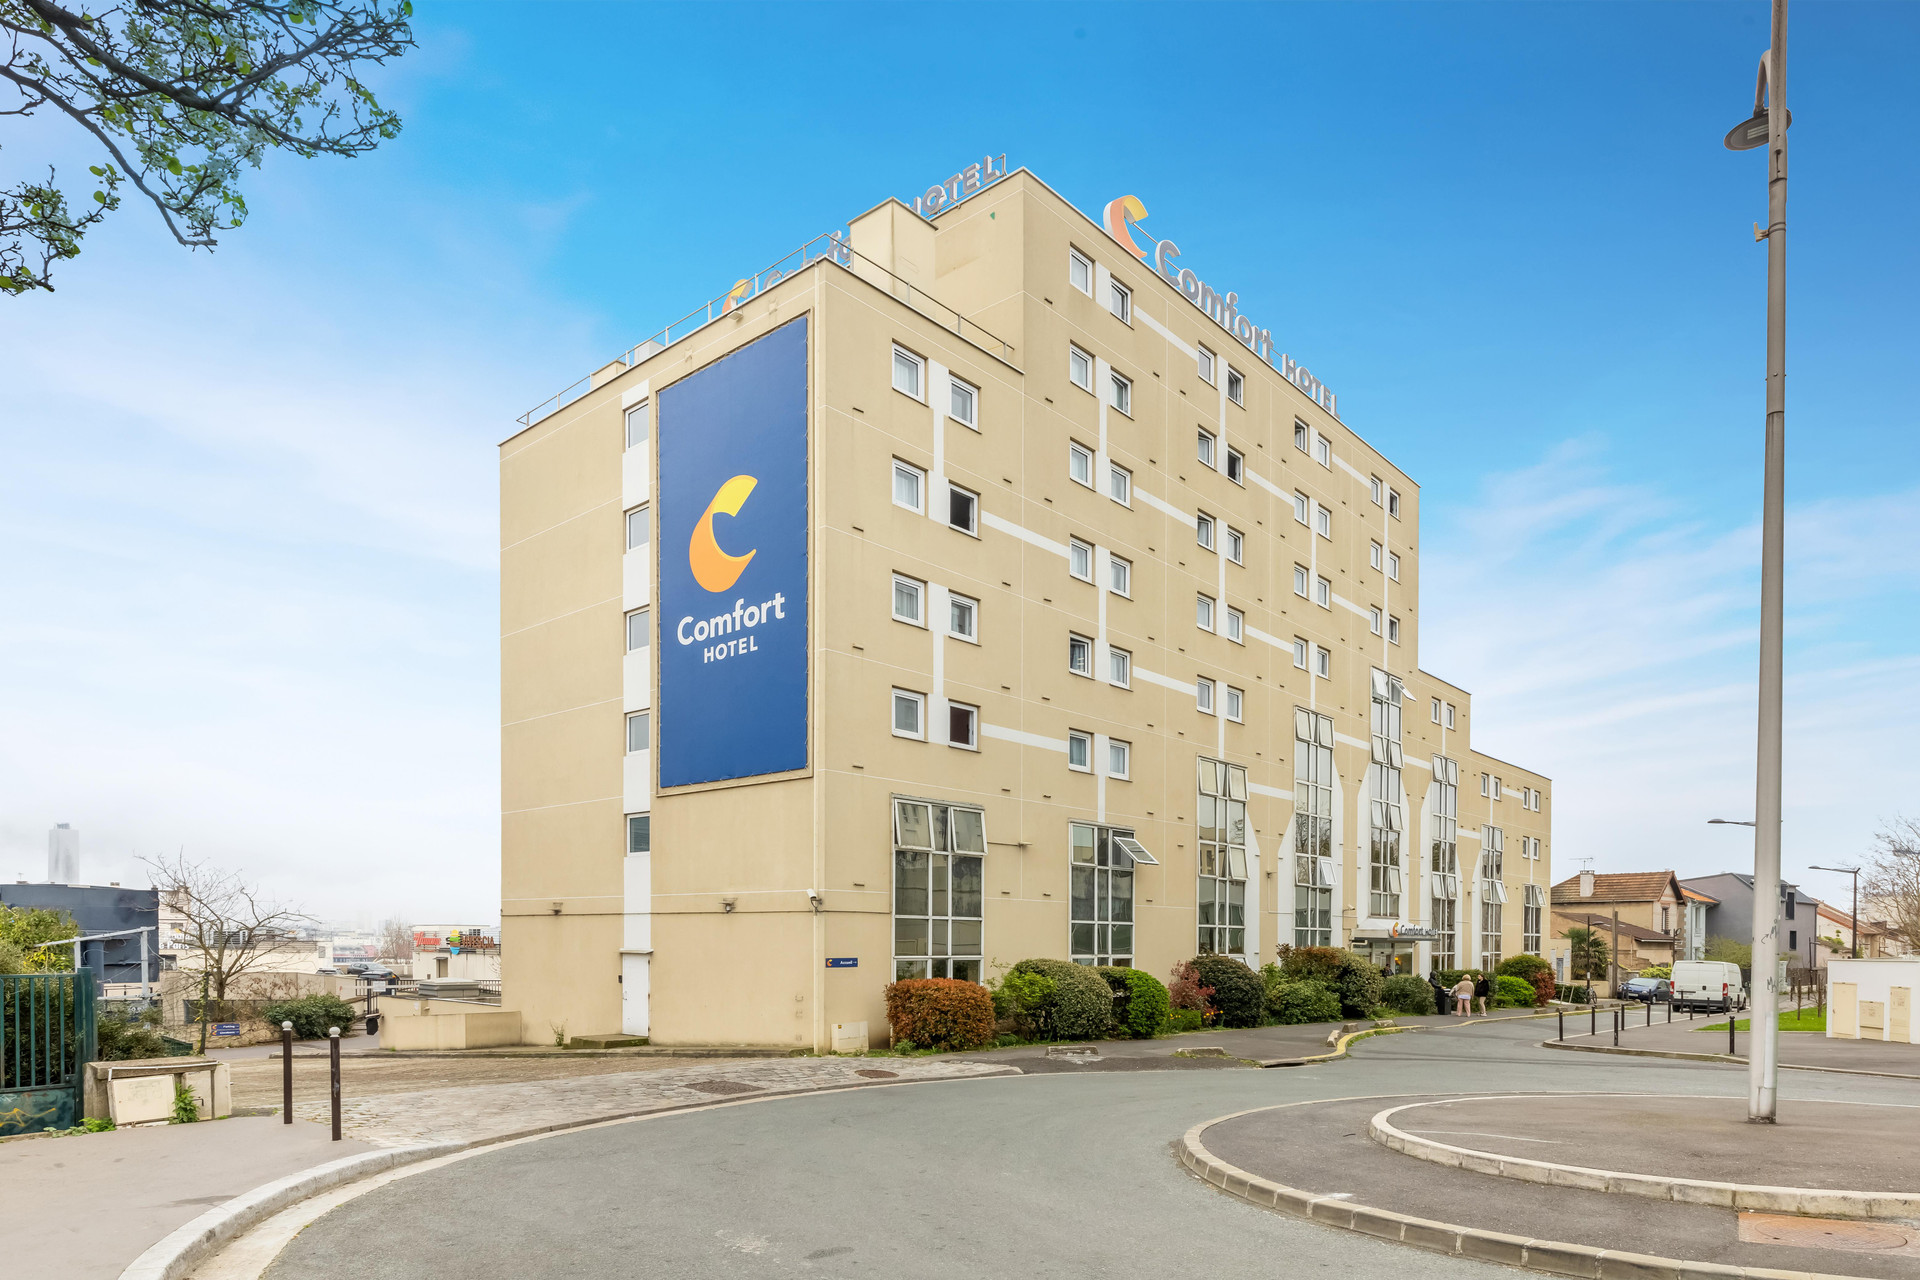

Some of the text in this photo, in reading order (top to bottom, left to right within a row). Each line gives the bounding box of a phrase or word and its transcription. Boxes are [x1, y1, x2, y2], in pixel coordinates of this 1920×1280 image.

[1155, 240, 1340, 420] Comfort HOTEL
[677, 592, 785, 645] Comfort
[704, 636, 758, 663] HOTEL
